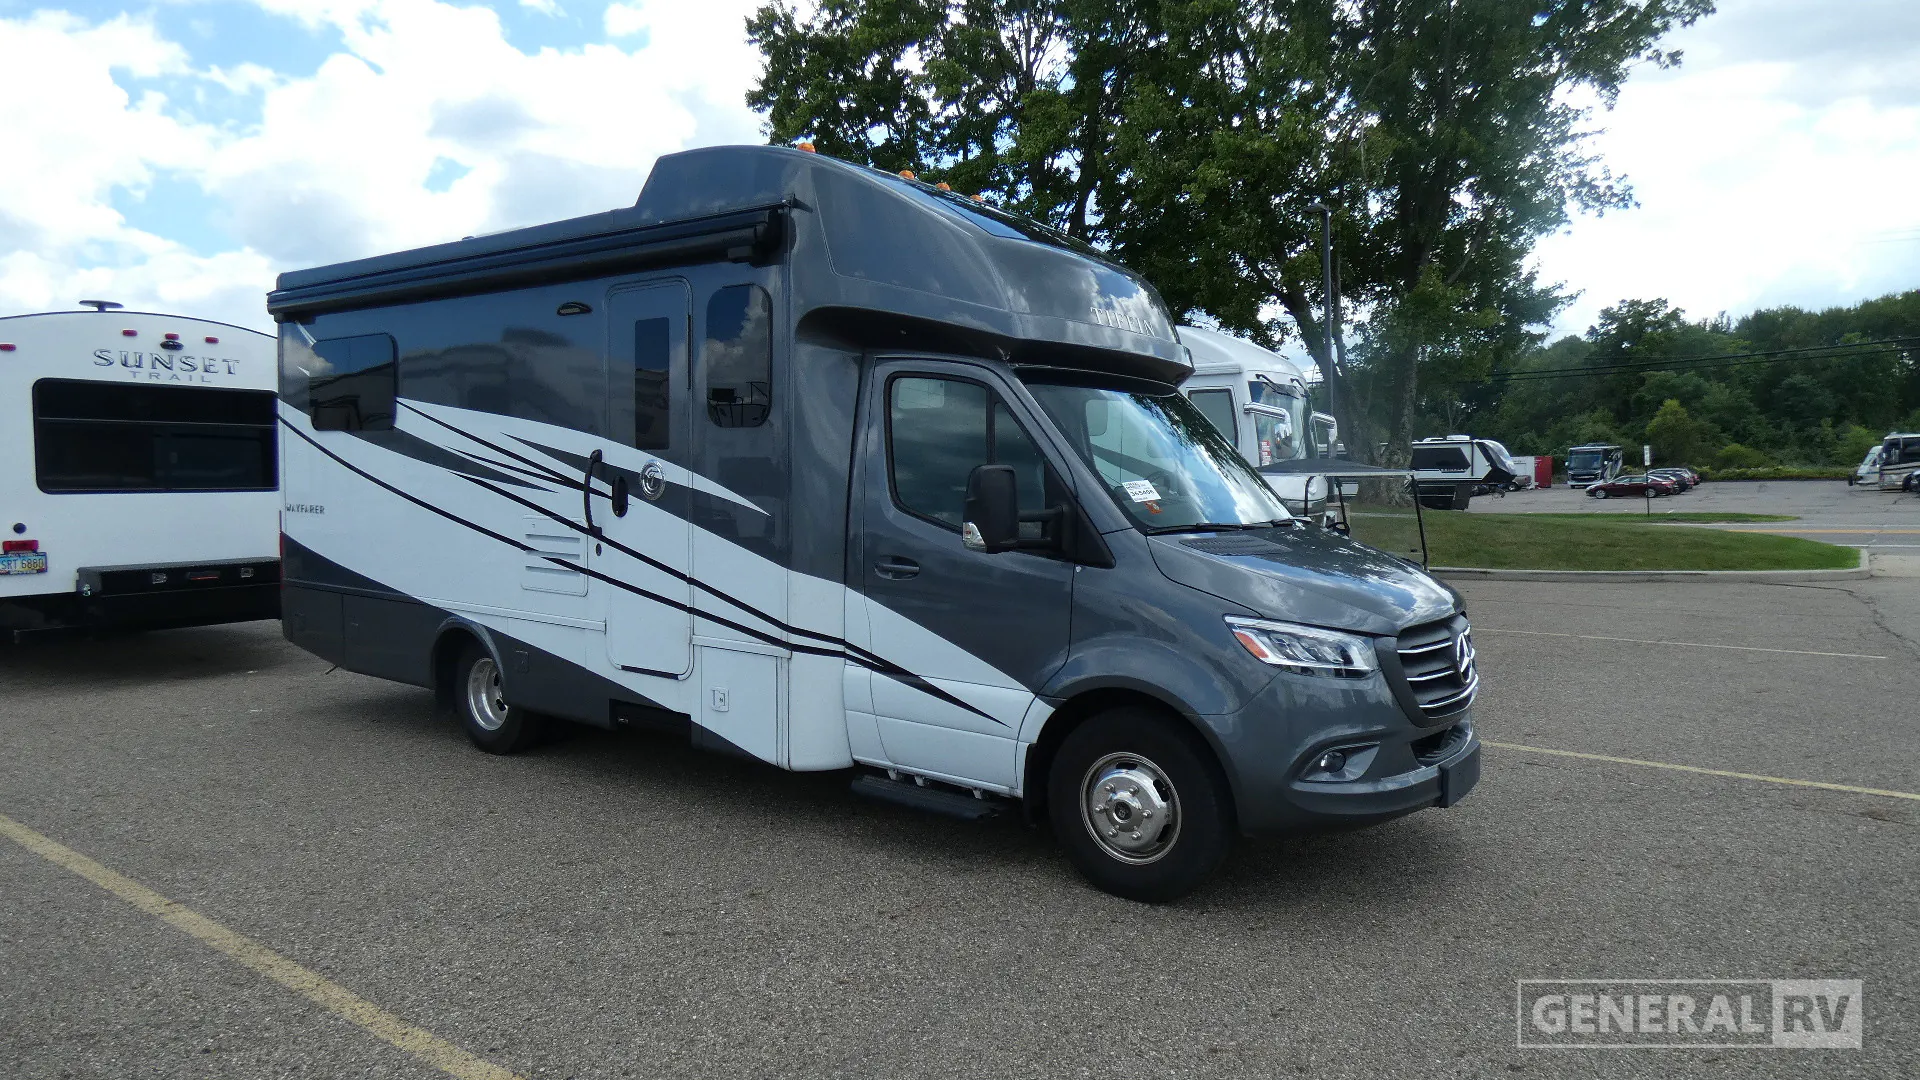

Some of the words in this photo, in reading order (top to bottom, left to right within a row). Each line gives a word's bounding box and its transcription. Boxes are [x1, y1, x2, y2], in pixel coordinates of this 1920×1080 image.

[1090, 306, 1155, 337] TIFFIN
[93, 349, 240, 375] SUNSET
[128, 370, 211, 383] TRAIL
[286, 503, 325, 514] WAYFARER
